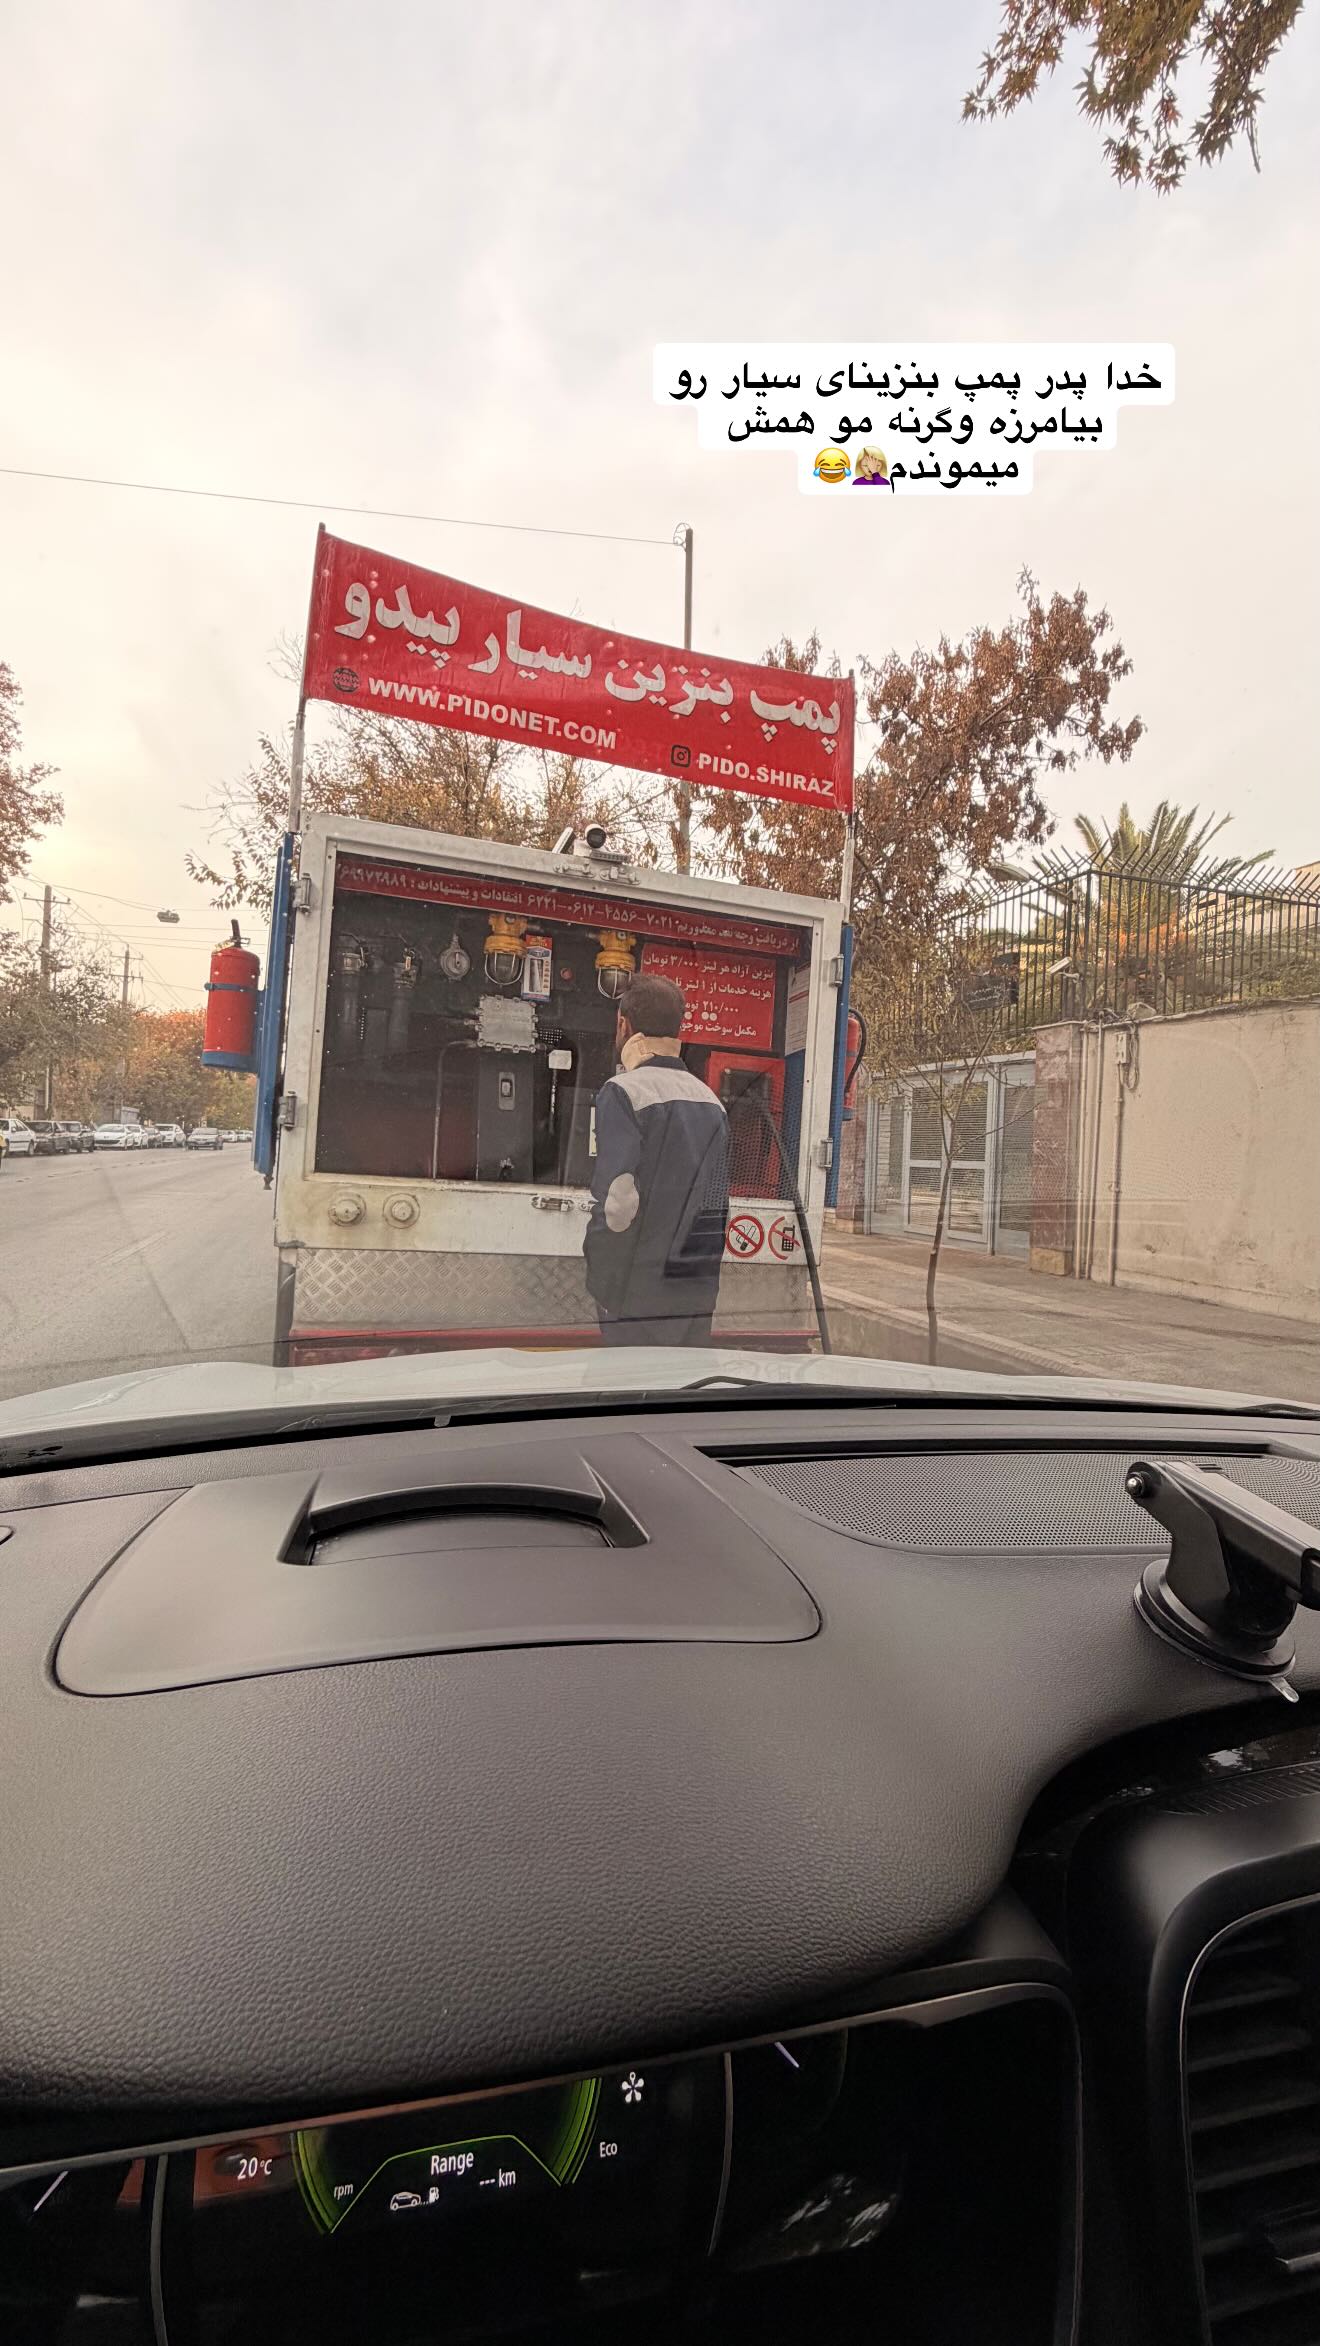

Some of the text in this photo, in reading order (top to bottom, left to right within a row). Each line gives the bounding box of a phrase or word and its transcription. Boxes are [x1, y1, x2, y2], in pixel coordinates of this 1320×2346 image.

[334, 582, 841, 755] پمپ بنزین سیار پیدو
[368, 677, 617, 750] WWW.PIDONET.COM
[698, 752, 835, 797] PIDO.SHIRAZ
[471, 890, 479, 901] و
[480, 888, 522, 905] انتقادات
[643, 952, 669, 967] تومان
[701, 961, 717, 973] لیتر
[719, 965, 730, 975] هر
[732, 964, 749, 978] آزاد
[751, 968, 774, 981] بنزین
[683, 979, 699, 992] لیتر
[708, 981, 717, 994] از
[718, 982, 748, 996] خدمات
[749, 988, 772, 1001] هزینه
[680, 1020, 757, 1037] مکمل سوخت موجو
[599, 2141, 618, 2158] Eco
[430, 2152, 474, 2176] Range
[498, 2168, 516, 2188] km
[333, 2183, 354, 2199] rpm
